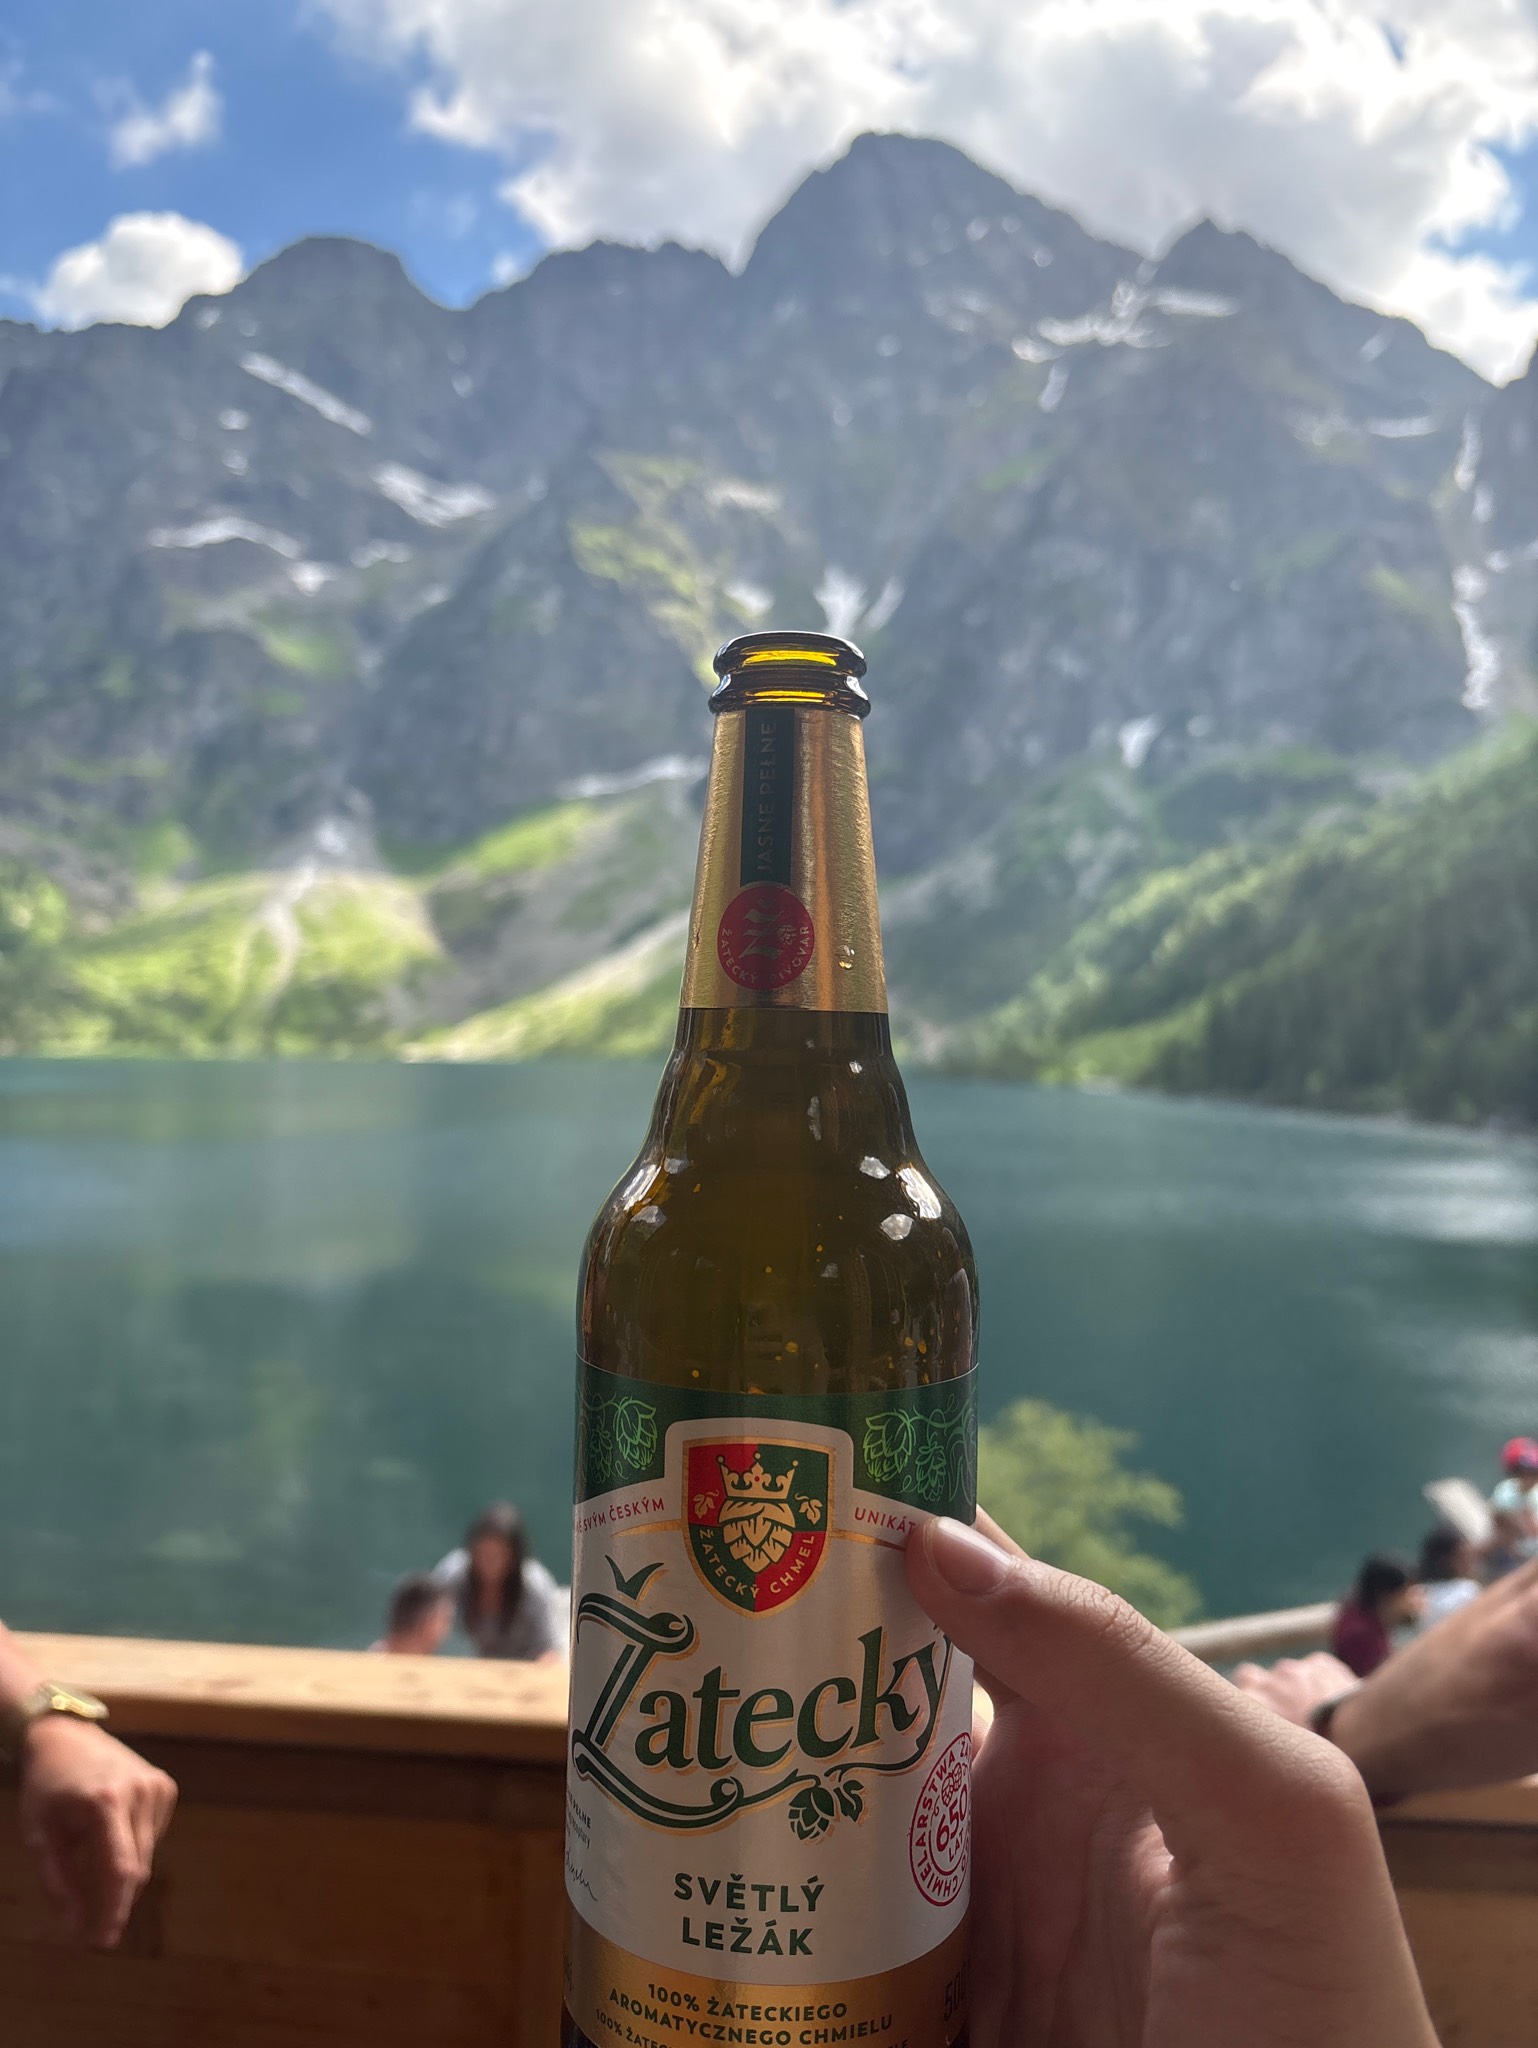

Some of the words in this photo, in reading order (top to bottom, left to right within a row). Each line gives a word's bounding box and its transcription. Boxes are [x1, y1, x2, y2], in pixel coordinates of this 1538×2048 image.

[760, 723, 777, 797] PEŁNE
[757, 803, 775, 875] JASNE
[720, 927, 758, 984] ŽATECKÝ
[768, 925, 809, 984] PIVOVAR
[584, 1512, 607, 1532] SVÝM
[609, 1496, 665, 1522] ČESKÝM
[699, 1527, 760, 1600] ŽATECKÝ
[769, 1535, 815, 1595] CHMEL
[936, 1784, 968, 1852] 650
[948, 1828, 964, 1863] LAT
[673, 1871, 825, 1913] SVĚTLÝ
[681, 1916, 814, 1956] LEŽÁK
[595, 2008, 623, 2037] 100%
[609, 1987, 791, 2046] AROMATYCZNEGO
[799, 2013, 893, 2045] CHMIELU
[647, 1982, 701, 2013] 100%
[706, 1996, 848, 2023] ŻATECKIEGO
